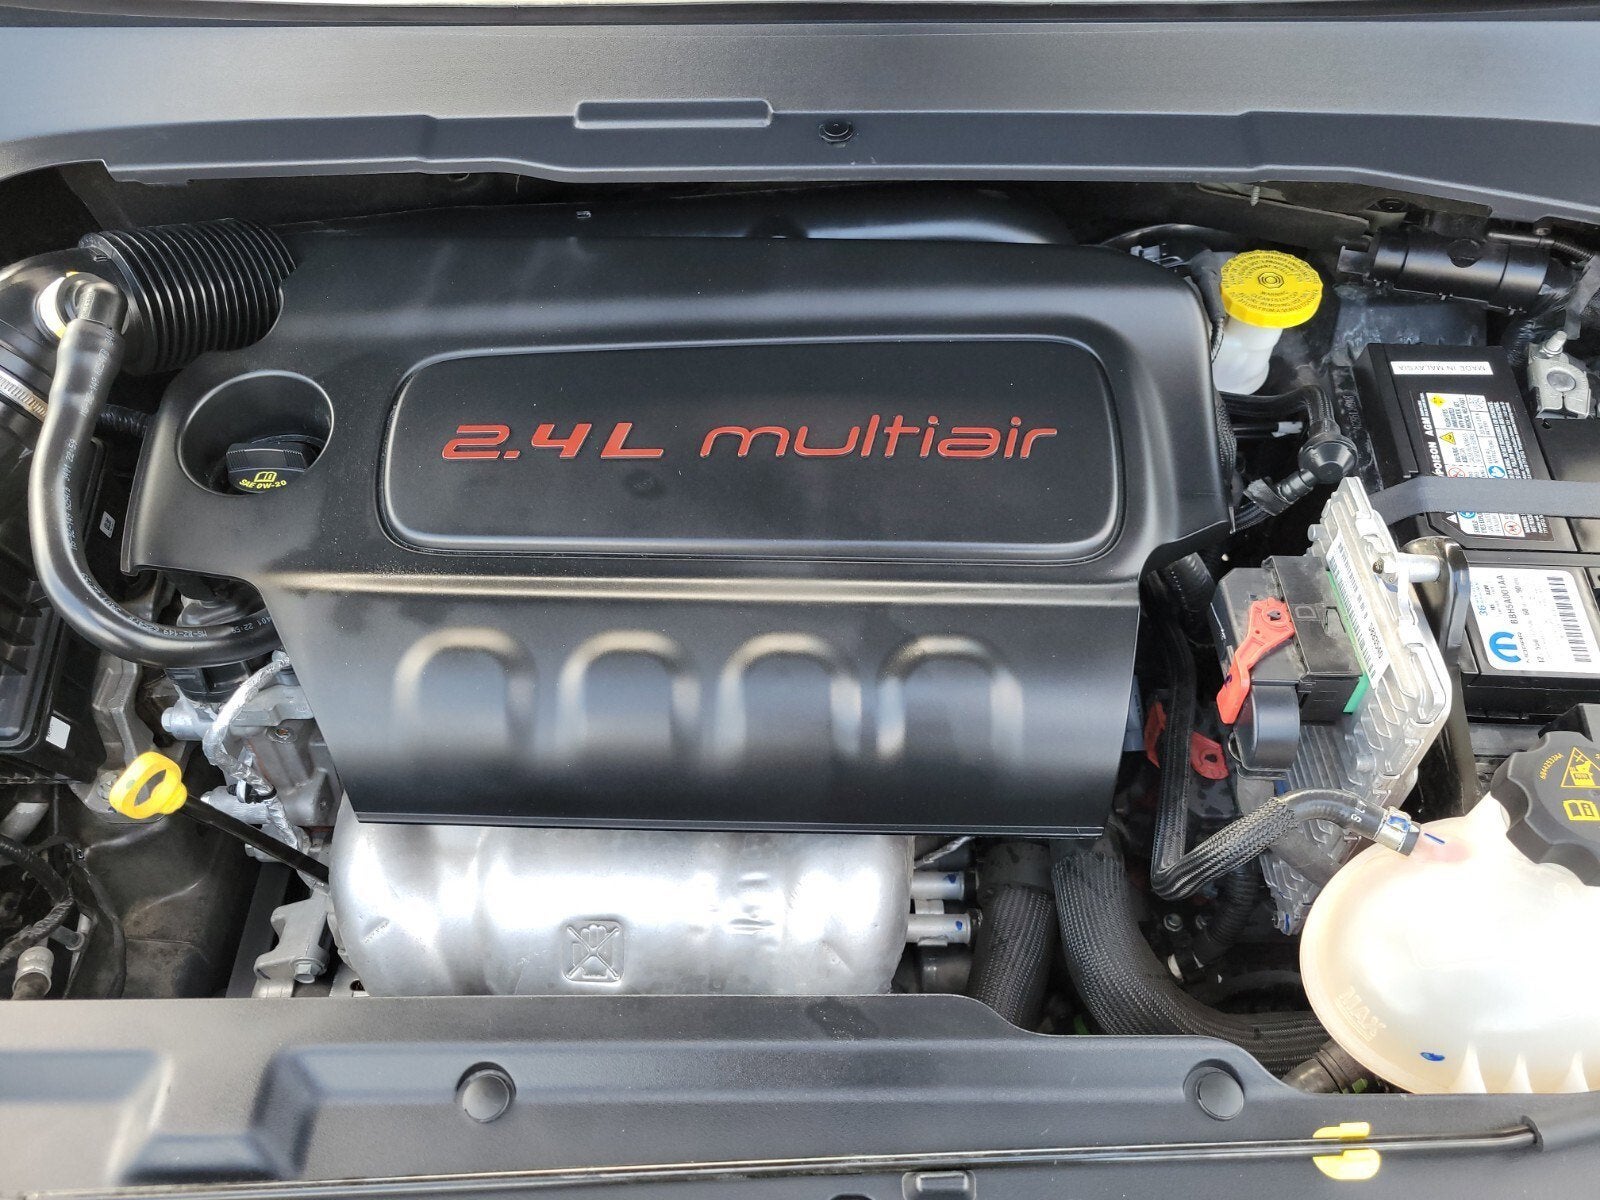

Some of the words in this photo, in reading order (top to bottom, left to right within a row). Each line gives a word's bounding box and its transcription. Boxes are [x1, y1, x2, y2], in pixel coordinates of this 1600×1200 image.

[699, 414, 1059, 460] multiair
[239, 478, 256, 488] SAE
[256, 480, 287, 490] 0W-20
